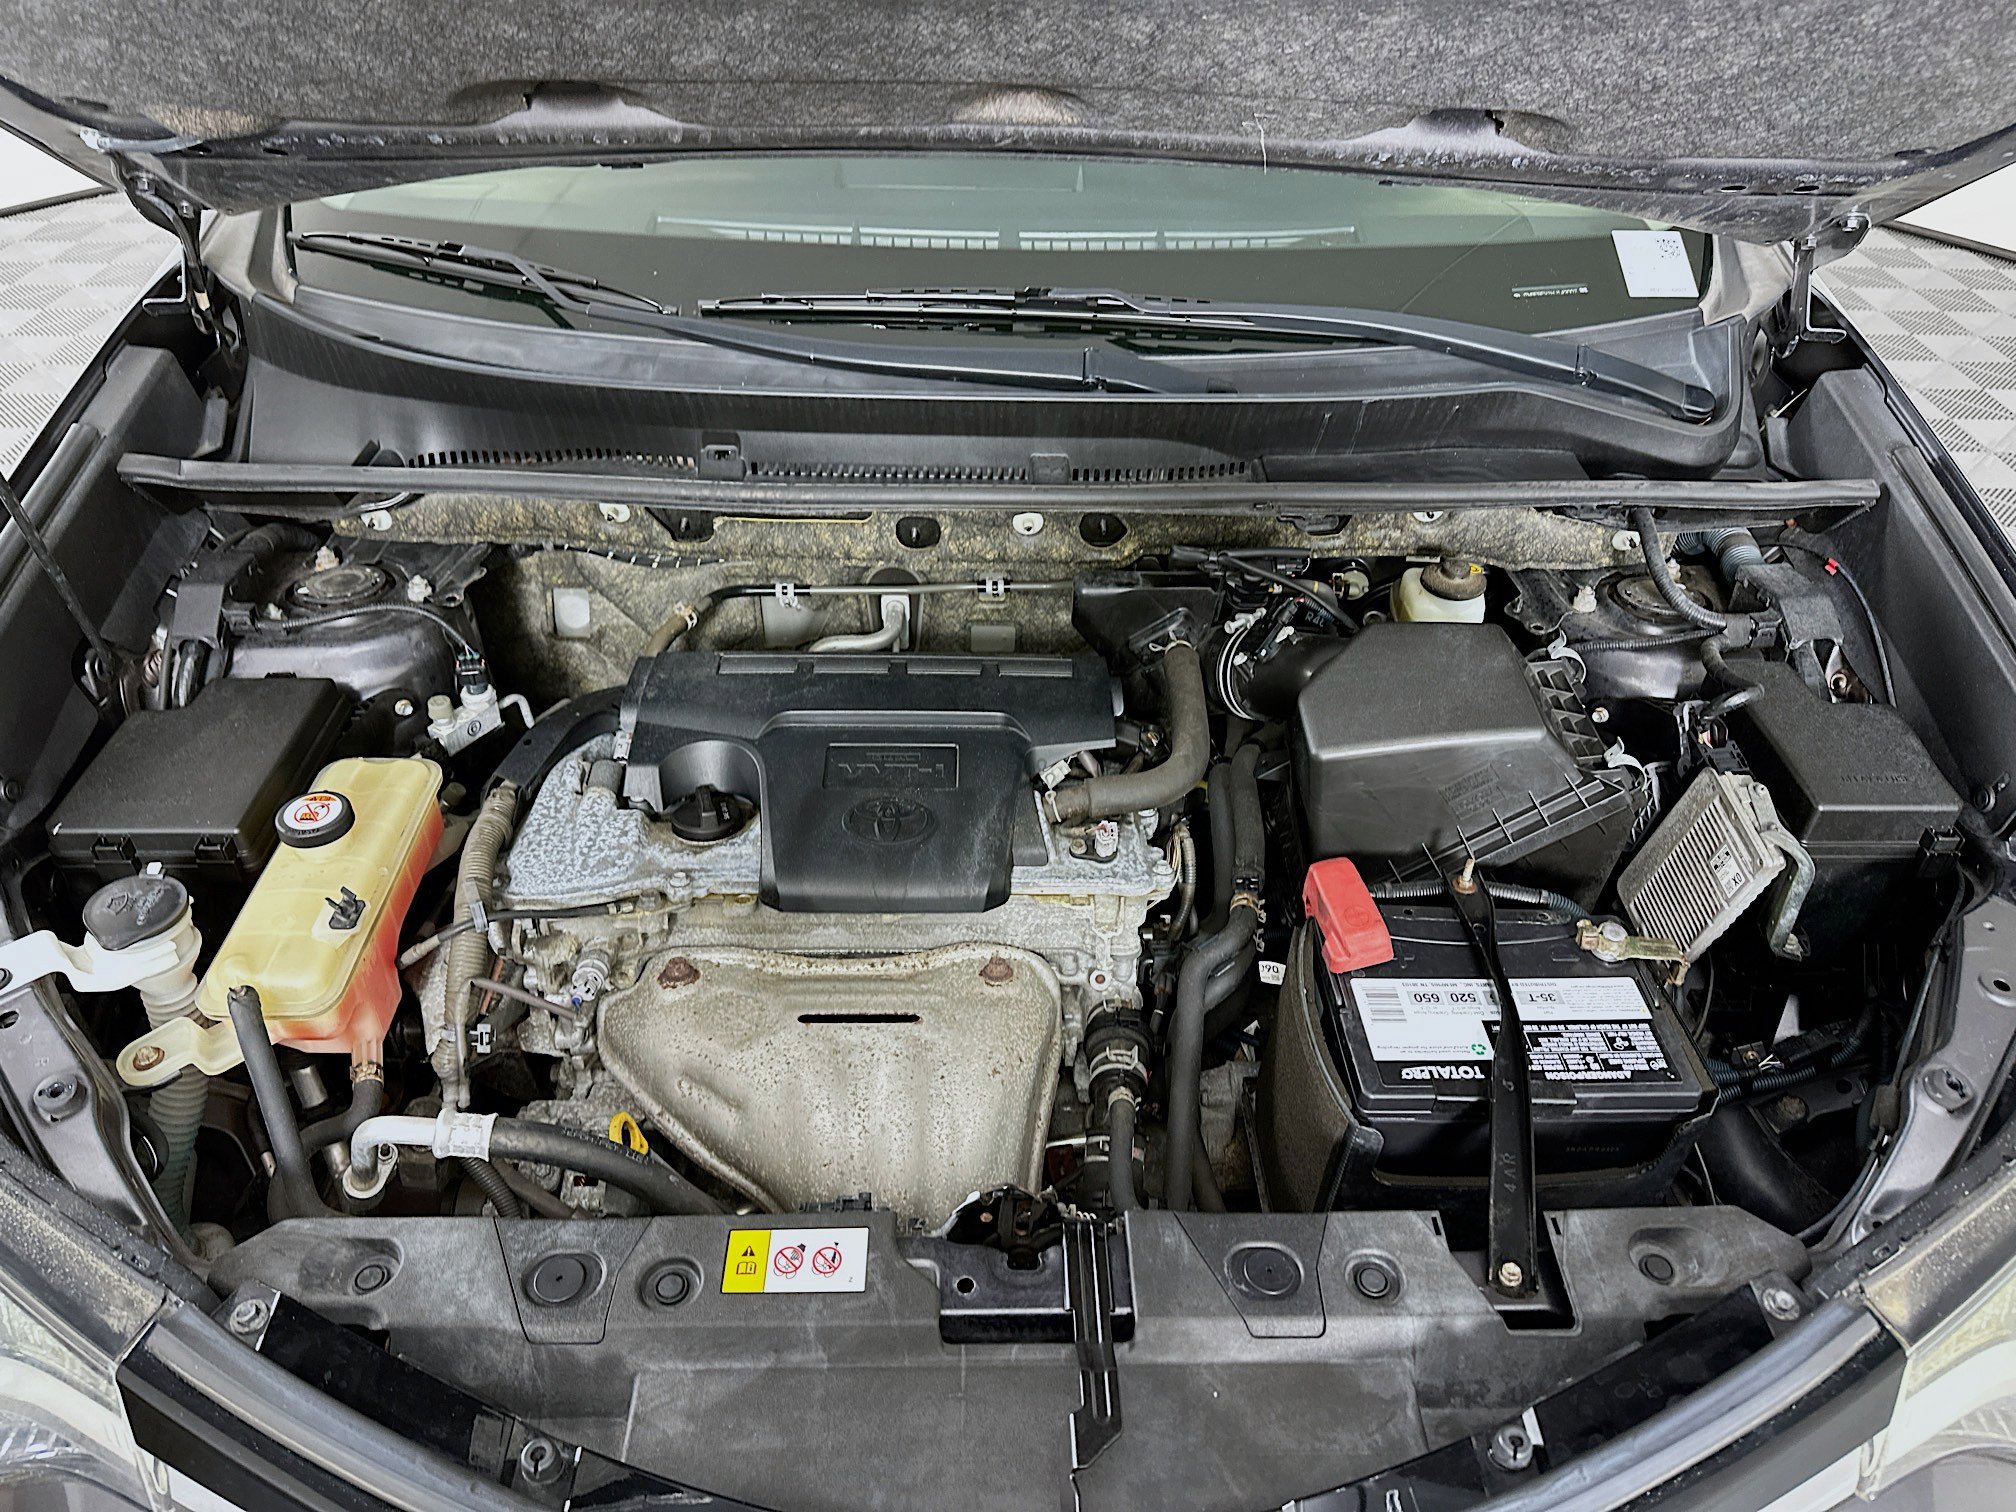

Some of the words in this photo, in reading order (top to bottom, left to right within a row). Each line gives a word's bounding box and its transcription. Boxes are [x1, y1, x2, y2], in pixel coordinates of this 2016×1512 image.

[1414, 993, 1440, 1003] 650
[1450, 993, 1476, 1003] 520
[1528, 993, 1556, 1002] 35-T
[1400, 1066, 1486, 1080] TOTALPRO
